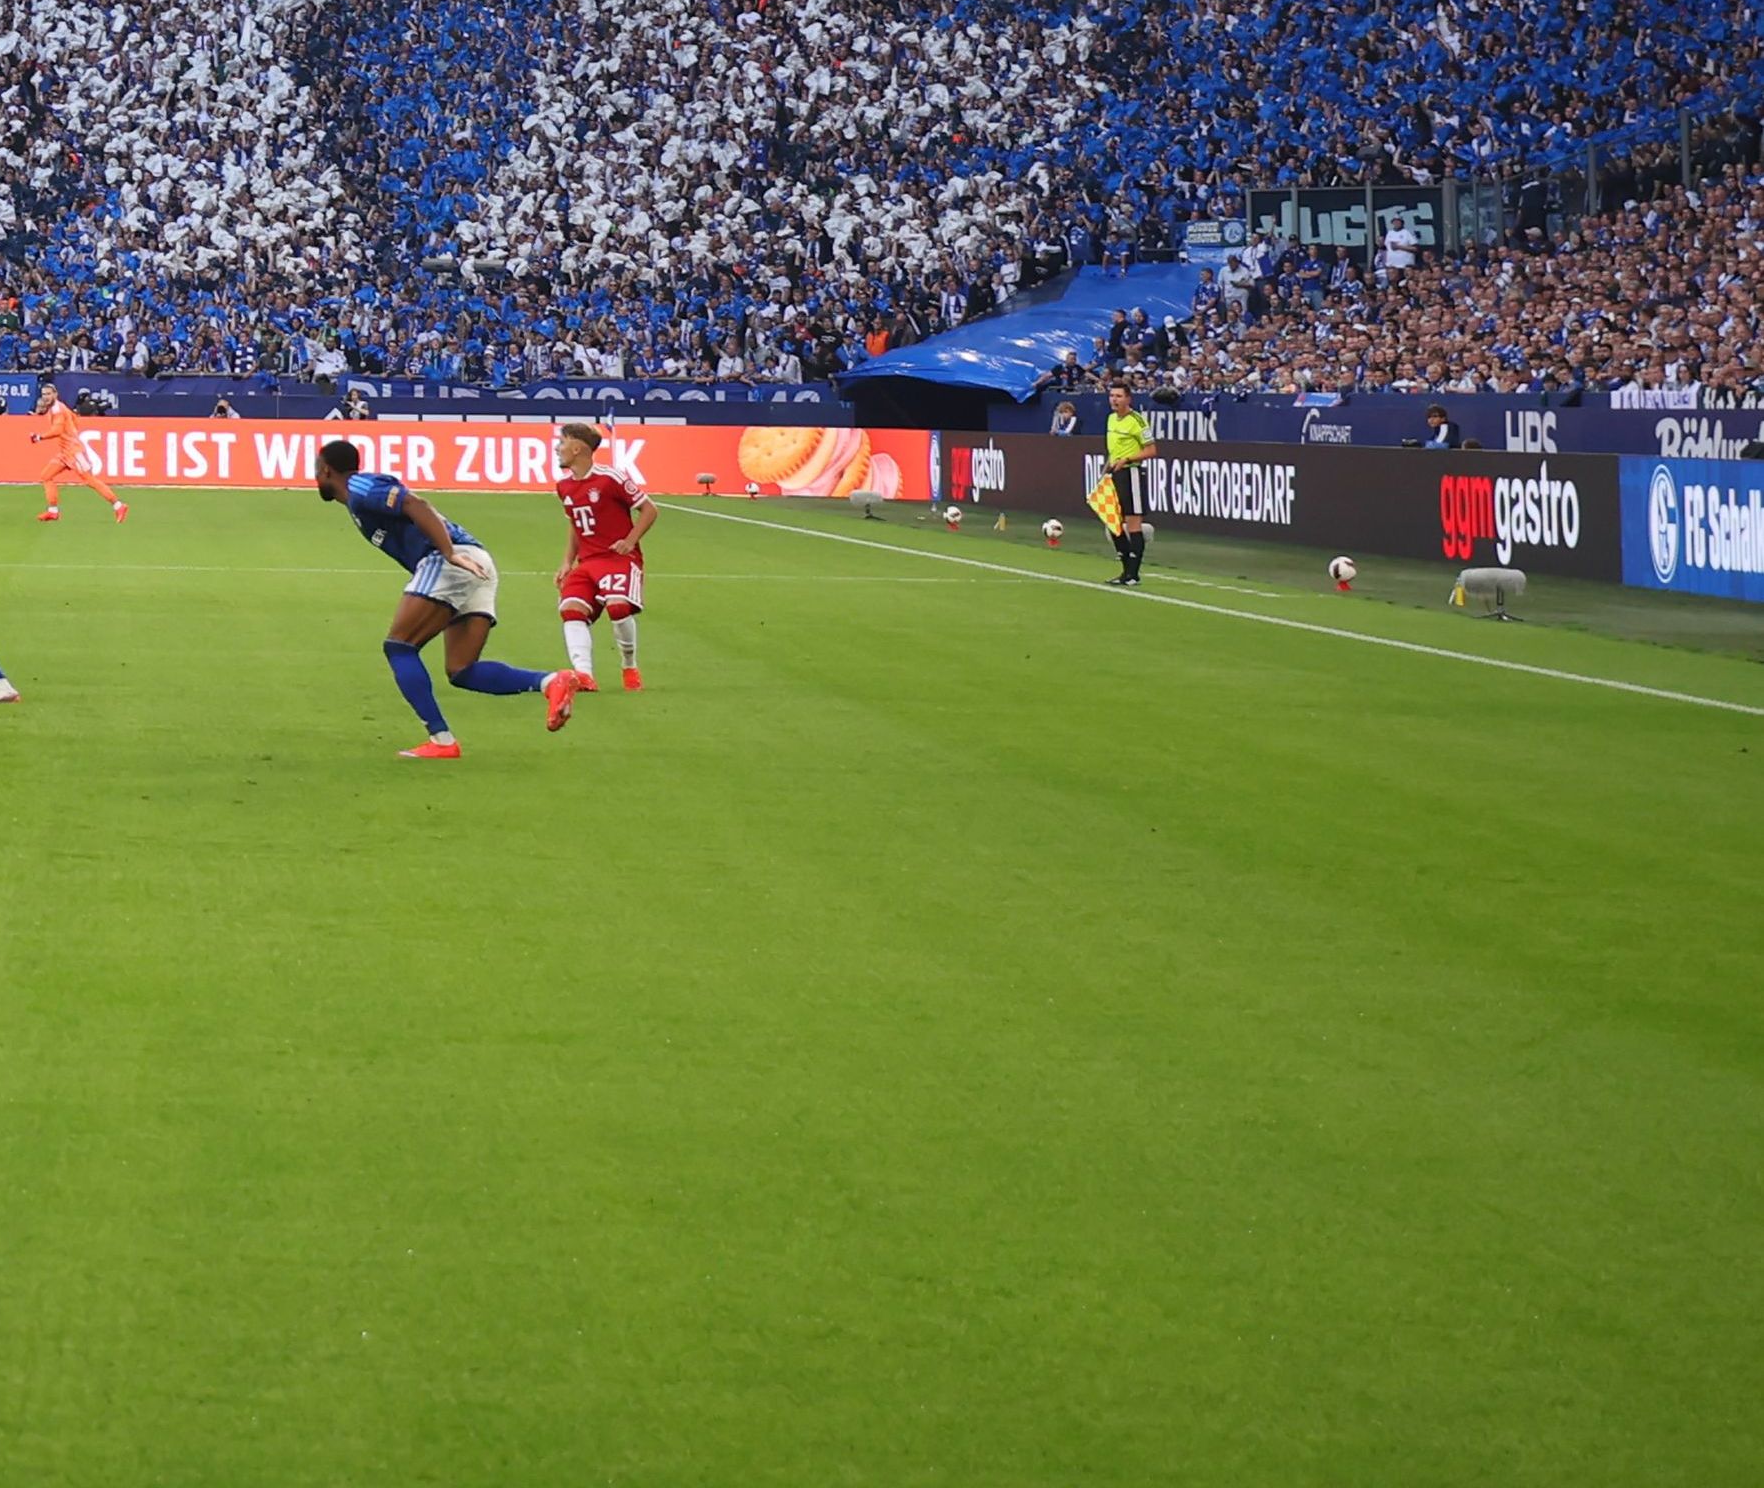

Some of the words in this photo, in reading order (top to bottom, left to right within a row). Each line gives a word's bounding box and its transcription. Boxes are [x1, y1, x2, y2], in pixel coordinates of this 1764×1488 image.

[80, 429, 146, 478] SIE
[166, 431, 236, 479] IST
[1171, 459, 1296, 525] GASTROBEDARF
[1440, 460, 1580, 565] ggmgastro
[1684, 484, 1706, 569] FC
[598, 574, 627, 592] 42
